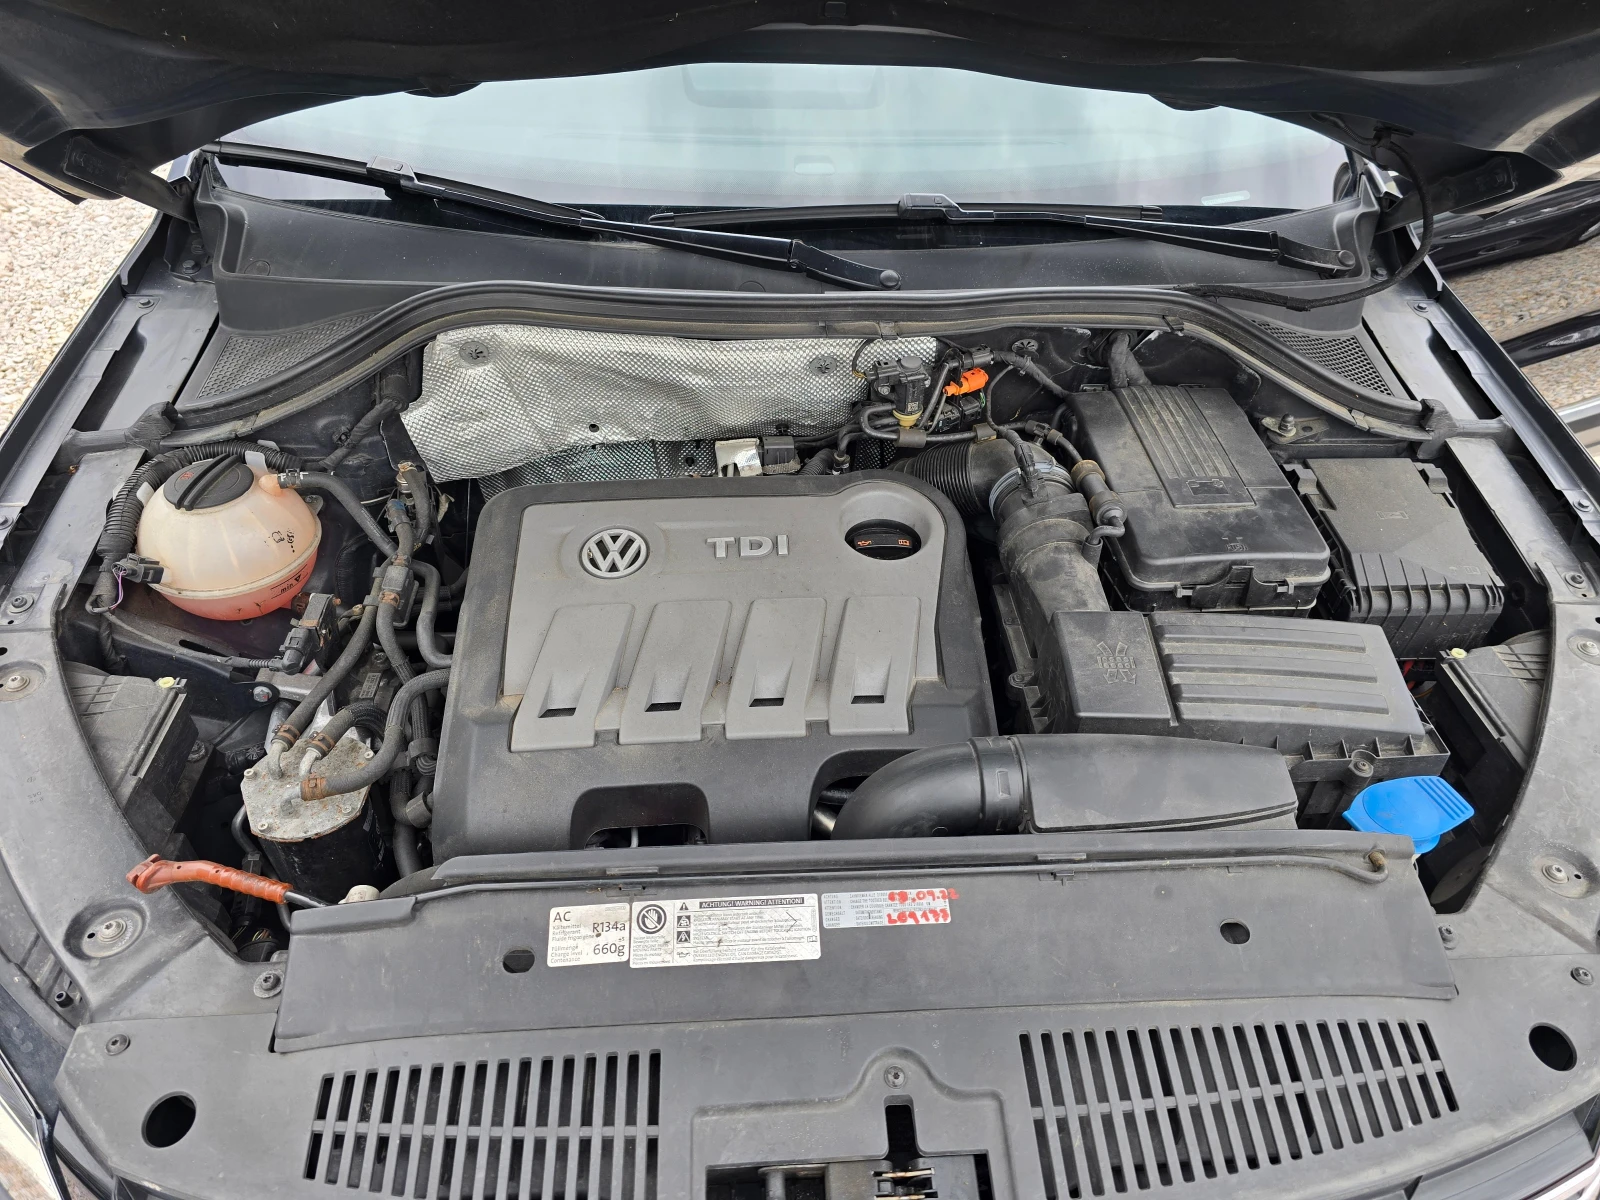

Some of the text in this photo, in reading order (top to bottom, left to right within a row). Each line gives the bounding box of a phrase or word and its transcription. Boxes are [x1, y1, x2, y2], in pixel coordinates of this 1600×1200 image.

[706, 534, 790, 559] TDI
[579, 527, 649, 579] VW
[280, 583, 294, 595] min
[735, 899, 767, 907] WARNING!
[553, 911, 571, 923] AC
[592, 921, 626, 933] R134a
[593, 943, 626, 957] 660g
